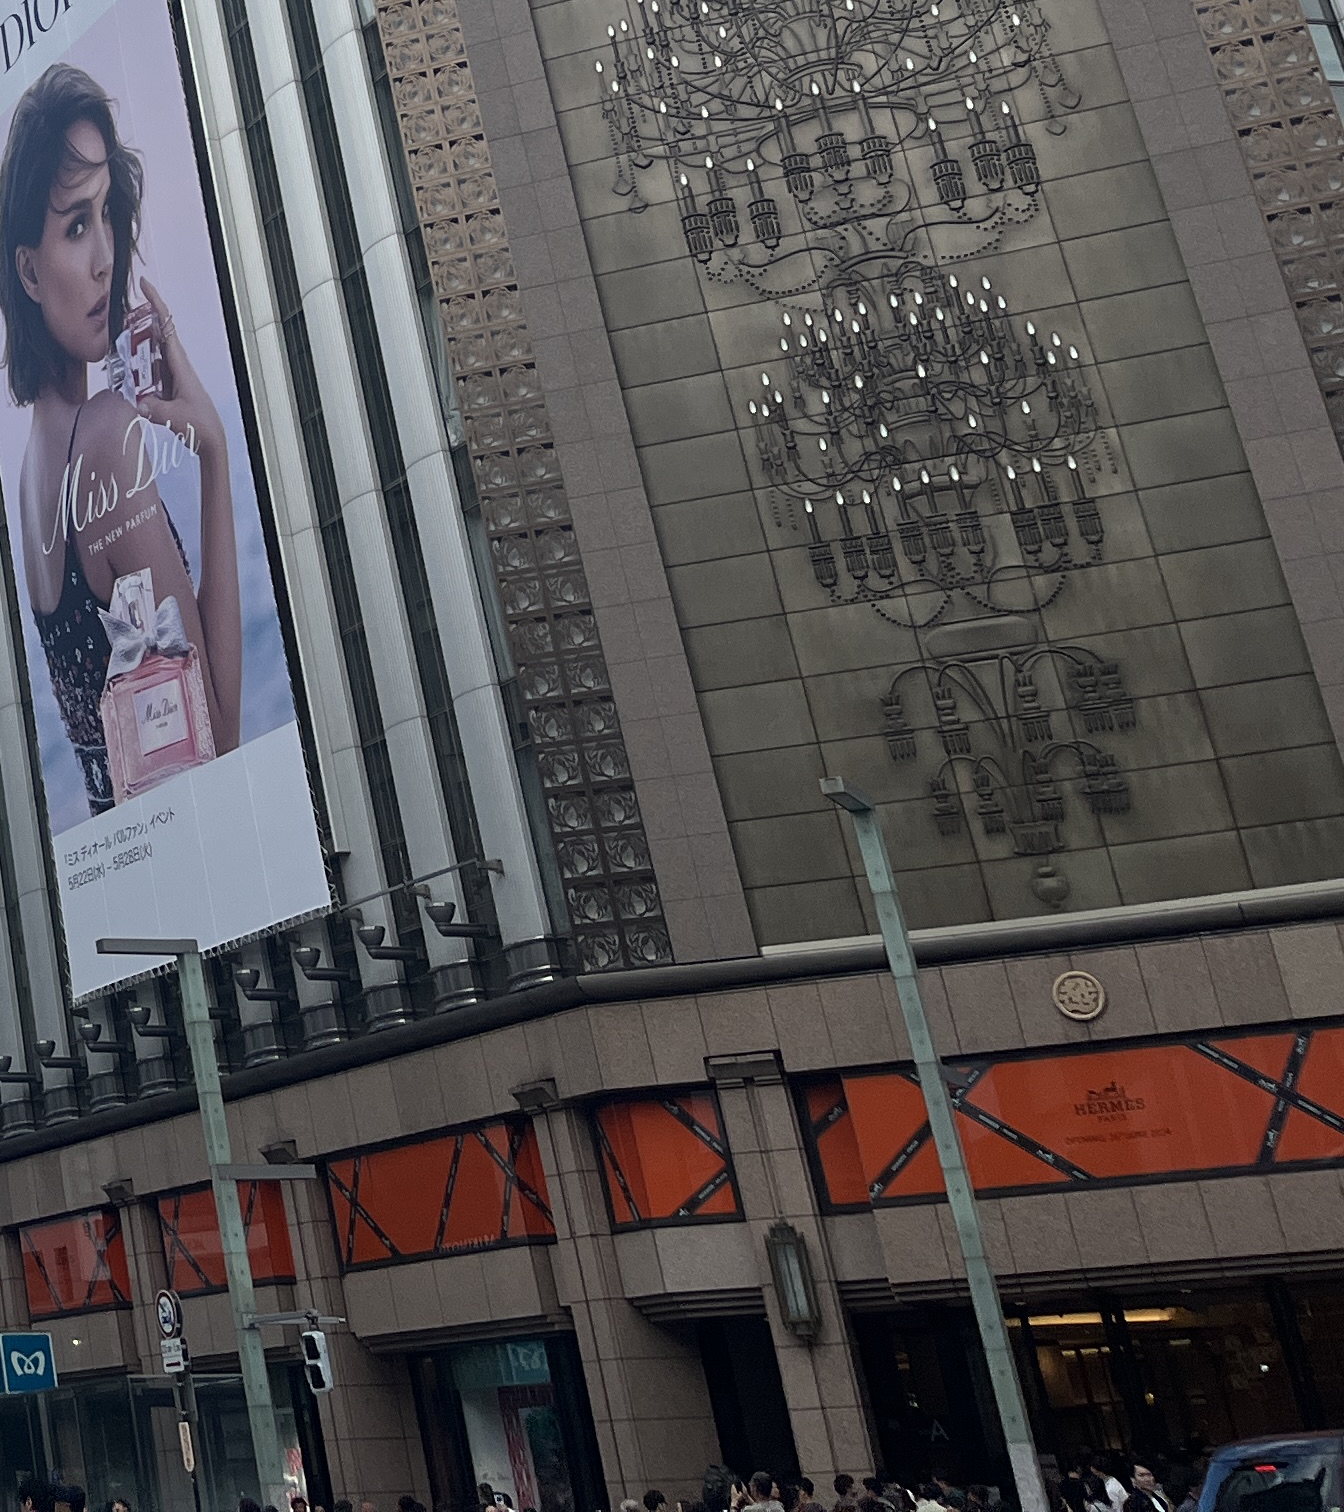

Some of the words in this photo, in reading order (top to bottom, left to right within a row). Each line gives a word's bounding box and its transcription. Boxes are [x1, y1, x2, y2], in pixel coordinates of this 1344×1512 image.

[42, 454, 118, 555] Miss
[123, 413, 200, 498] Dior
[88, 539, 104, 556] THE
[105, 525, 123, 546] NEW
[125, 504, 157, 531] PARFUM
[149, 807, 175, 829] イベント
